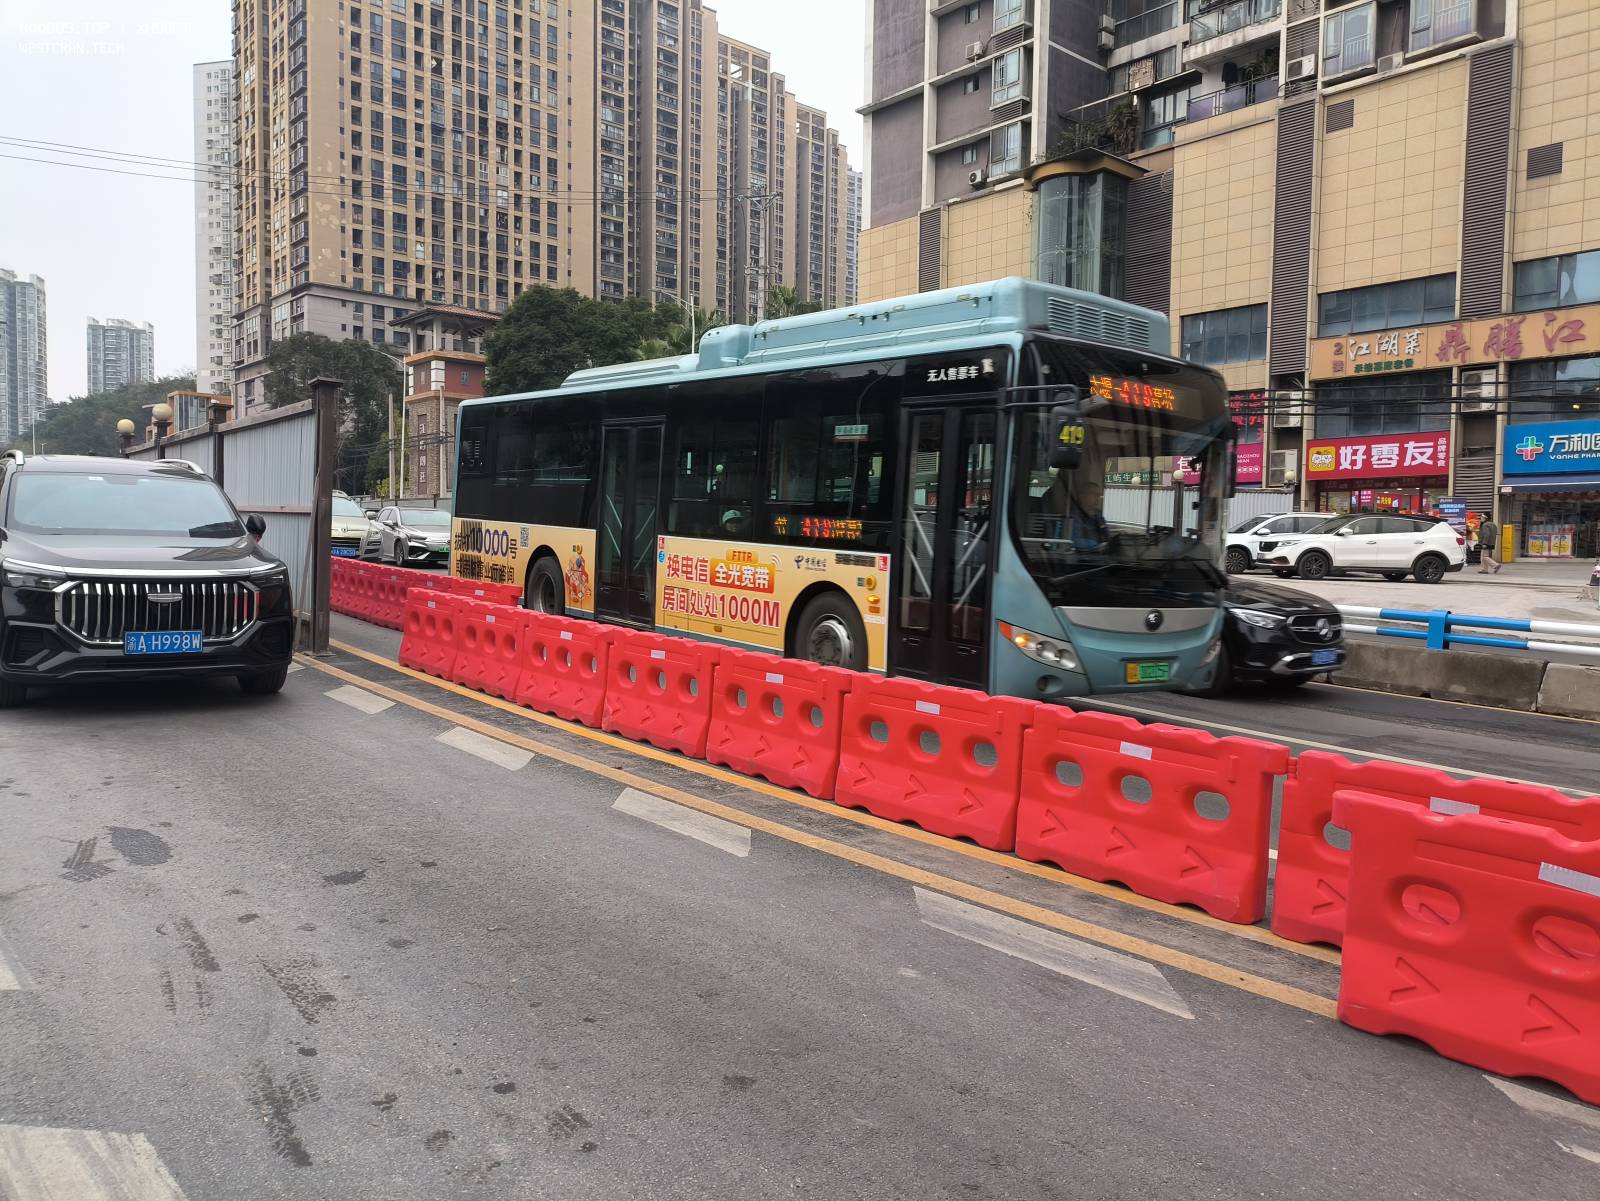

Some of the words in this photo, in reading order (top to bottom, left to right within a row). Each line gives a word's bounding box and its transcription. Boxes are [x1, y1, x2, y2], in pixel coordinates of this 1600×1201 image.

[1348, 329, 1424, 361] 江湖菜
[926, 366, 979, 382] 无人售票车
[667, 553, 708, 582] 换电信
[732, 550, 753, 562] FTTR
[715, 562, 770, 589] 全光宽带
[662, 585, 780, 628] 房间处处1000M
